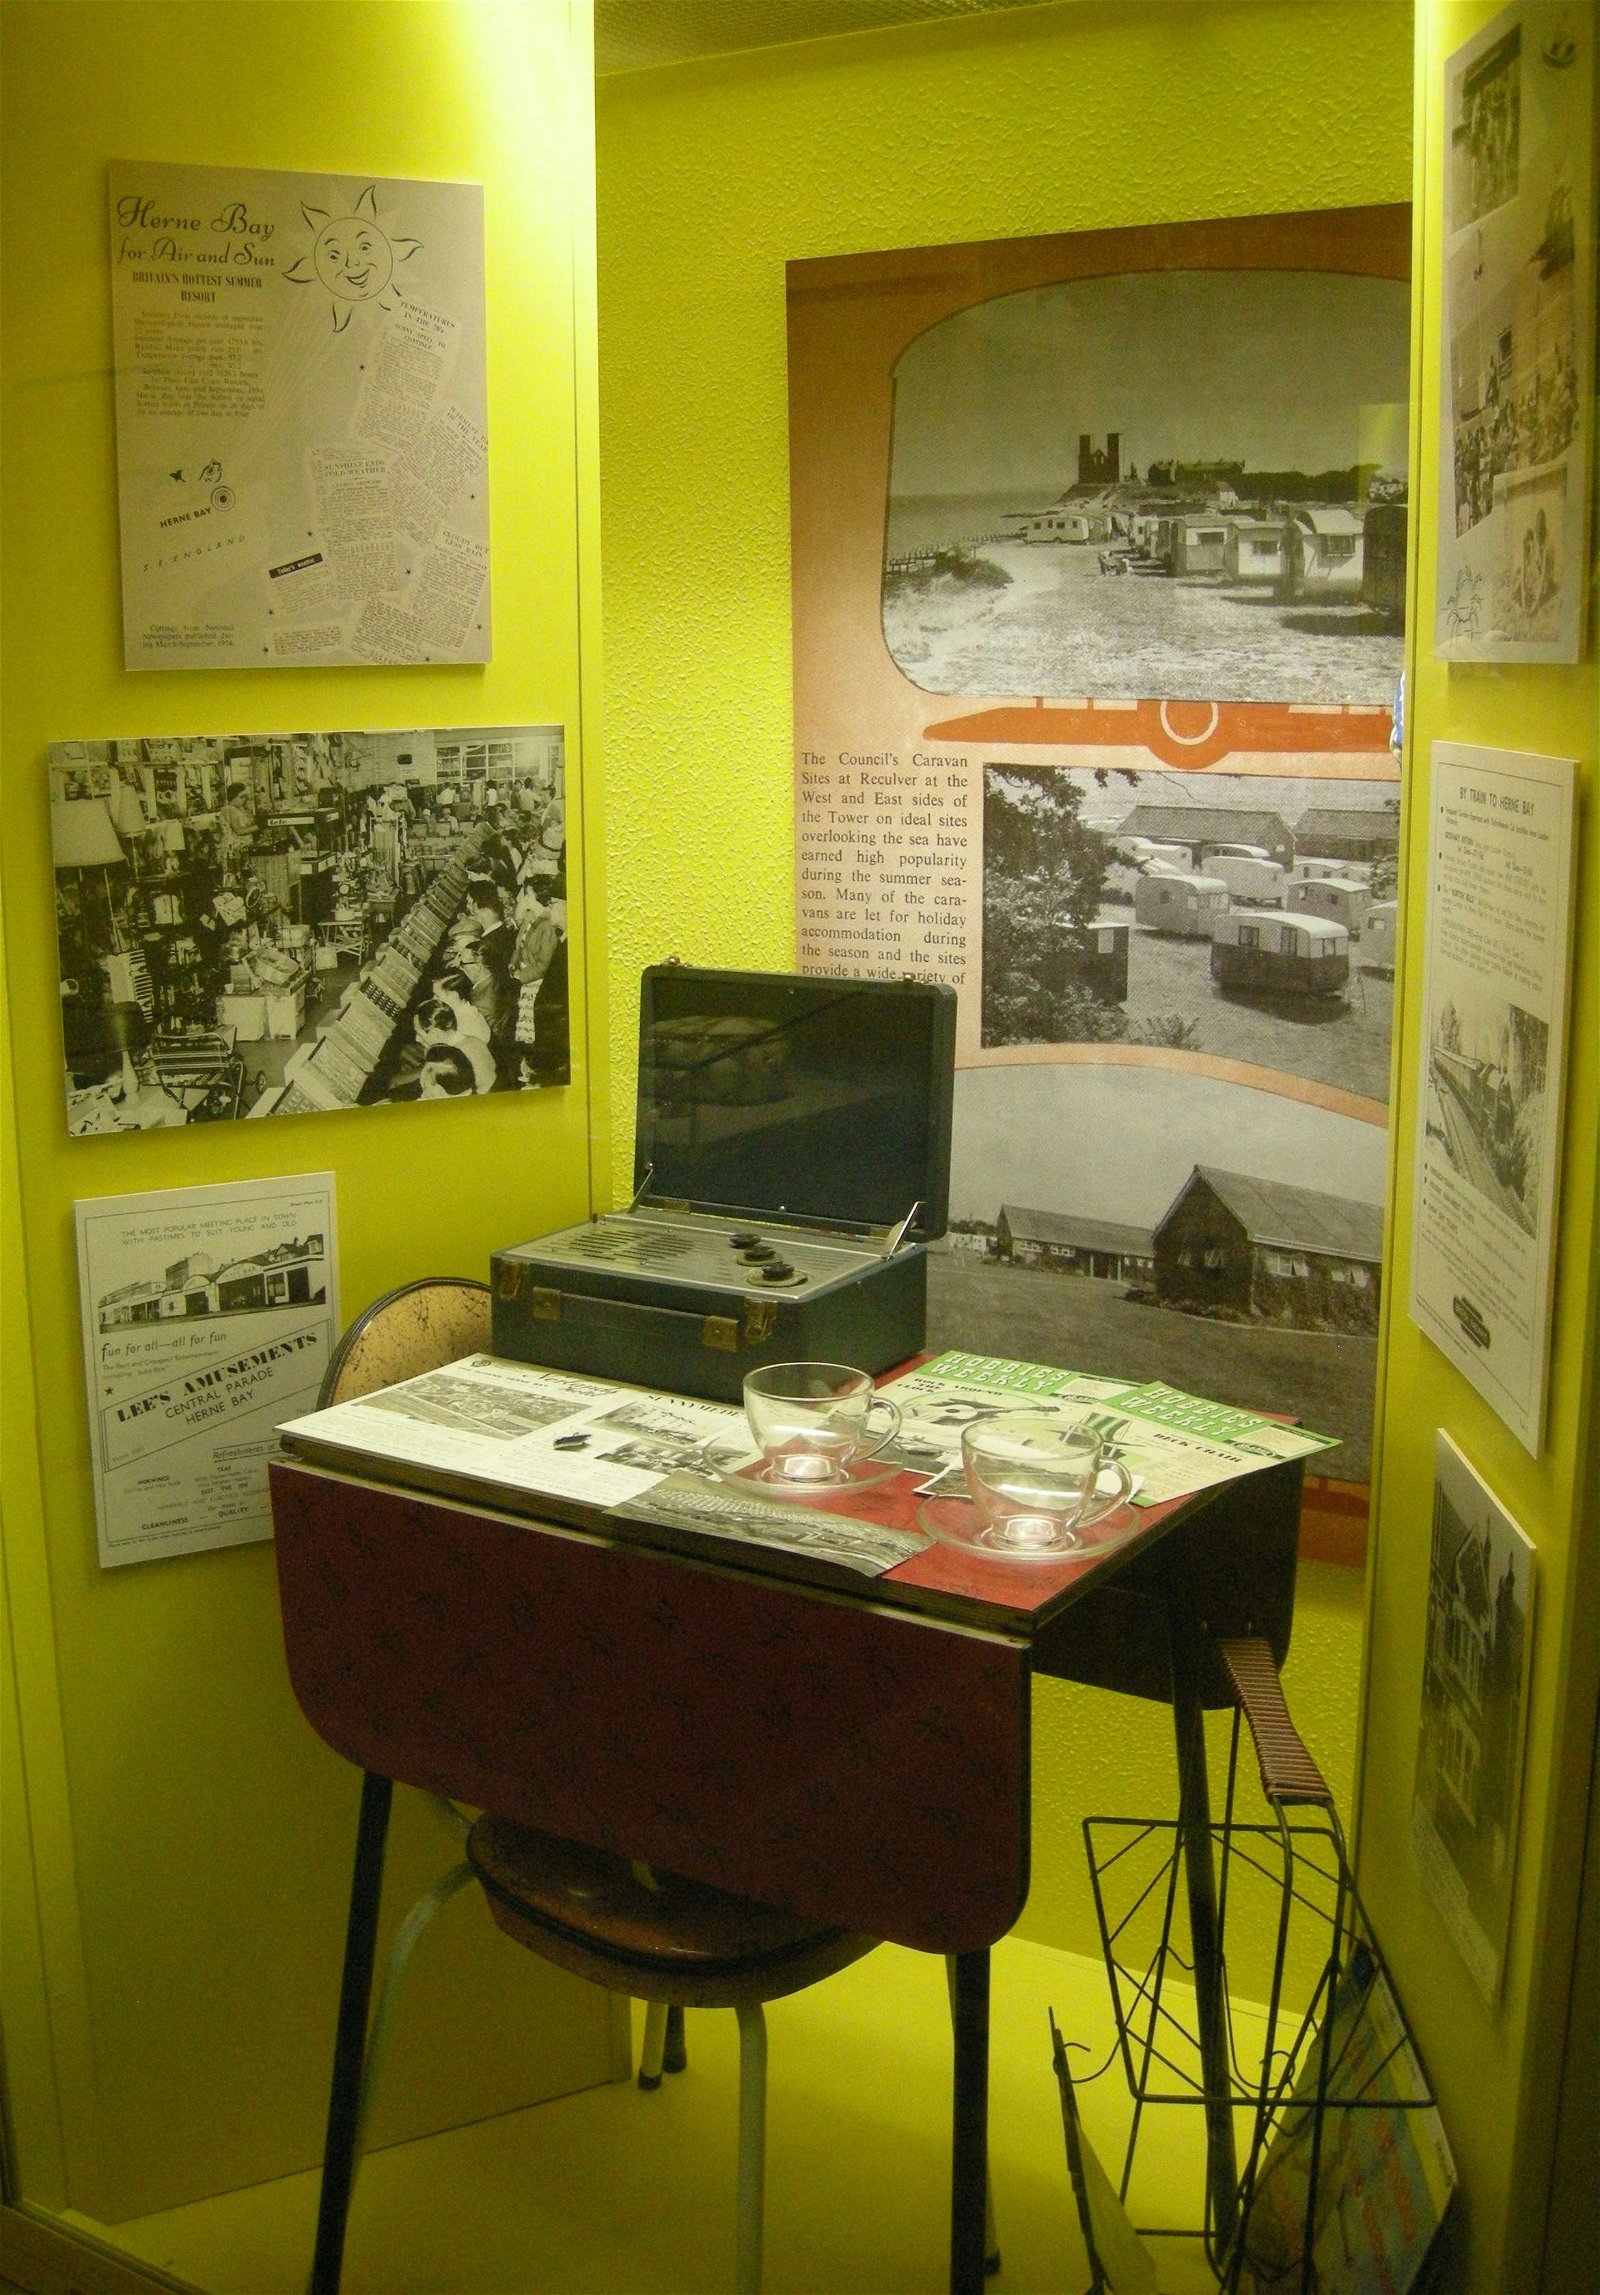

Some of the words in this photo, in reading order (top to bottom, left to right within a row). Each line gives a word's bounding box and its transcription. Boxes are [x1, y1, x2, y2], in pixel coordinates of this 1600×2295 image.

[117, 196, 200, 230] Herne
[211, 203, 275, 241] Bay
[117, 237, 146, 265] for
[151, 237, 193, 262] Air
[197, 241, 231, 263] and
[234, 242, 275, 266] Sun
[132, 272, 180, 283] BRITAIN'S
[182, 274, 221, 286] HOTTEST
[225, 276, 262, 288] SUMMER
[181, 291, 216, 303] RESORT
[401, 301, 455, 327] TEMPERATURES
[160, 513, 191, 528] HERNE
[193, 507, 212, 519] BAY
[174, 535, 245, 562] ENGLAND
[802, 753, 825, 765] The
[839, 753, 899, 765] Council's
[913, 754, 968, 767] Caravan
[802, 772, 830, 784] Sites
[839, 774, 850, 784] at
[861, 773, 917, 786] Reculver
[925, 775, 937, 787] at
[947, 775, 968, 787] the
[802, 792, 832, 803] West
[841, 792, 864, 804] and
[875, 792, 902, 805] East
[912, 794, 944, 806] sides
[953, 794, 968, 807] of
[1460, 787, 1466, 799] BY
[1470, 788, 1486, 804] TRAIN
[1489, 793, 1497, 807] TO
[1500, 796, 1519, 813] HERNE
[1522, 800, 1534, 816] BAY
[802, 811, 821, 823] the
[829, 811, 869, 824] Tower
[876, 815, 892, 824] on
[901, 813, 931, 826] ideal
[939, 814, 968, 827] sites
[802, 830, 877, 846] overlooking
[883, 832, 903, 844] the
[909, 835, 929, 845] sea
[936, 833, 968, 847] have
[801, 850, 842, 861] earned
[857, 850, 885, 865] high
[899, 853, 967, 869] popularity
[801, 868, 842, 883] during
[852, 870, 871, 882] the
[879, 873, 932, 885] summer
[941, 876, 967, 886] sea-
[801, 889, 826, 900] son.
[836, 888, 872, 904] Many
[881, 890, 896, 903] of
[905, 892, 925, 904] the
[934, 895, 967, 906] cara-
[802, 908, 830, 919] vans
[836, 910, 856, 920] are
[865, 908, 881, 921] let
[890, 910, 909, 923] for
[918, 912, 967, 929] holiday
[801, 927, 901, 942] accommodation
[924, 931, 967, 948] during
[802, 943, 821, 956] the
[829, 947, 869, 959] season
[878, 949, 901, 961] and
[910, 950, 930, 963] the
[938, 953, 966, 965] sites
[802, 963, 848, 976] provide
[853, 968, 860, 977] a
[867, 966, 896, 979] wide
[952, 972, 966, 985] of
[122, 1230, 136, 1238] THE
[140, 1227, 160, 1236] MOST
[163, 1223, 197, 1232] POPULAR
[200, 1219, 233, 1229] MEETING
[236, 1216, 257, 1224] PLACE
[274, 1212, 296, 1220] TOWN
[122, 1237, 144, 1245] WITH
[150, 1233, 185, 1242] PASTIMES
[206, 1228, 223, 1237] SUIT
[229, 1225, 254, 1234] YOUNG
[282, 1220, 297, 1228] OLD
[101, 1343, 120, 1361] fun
[125, 1343, 141, 1356] for
[190, 1335, 205, 1347] for
[209, 1331, 227, 1346] fun
[117, 1390, 171, 1422] LEE'S
[184, 1332, 317, 1397] AMUSEMENTS
[931, 1363, 1055, 1392] WEEKLY
[945, 1354, 1071, 1382] HOBBIES
[165, 1387, 221, 1419] CENTRAL
[226, 1367, 274, 1394] PARADE
[185, 1402, 226, 1425] HERNE
[233, 1391, 255, 1407] BAY
[1119, 1396, 1239, 1436] WEEKLY
[1142, 1386, 1265, 1428] HOBBIES
[1153, 1432, 1190, 1447] DECK
[141, 1517, 189, 1531] CLEANLINESS
[218, 1506, 249, 1518] QUALITY
